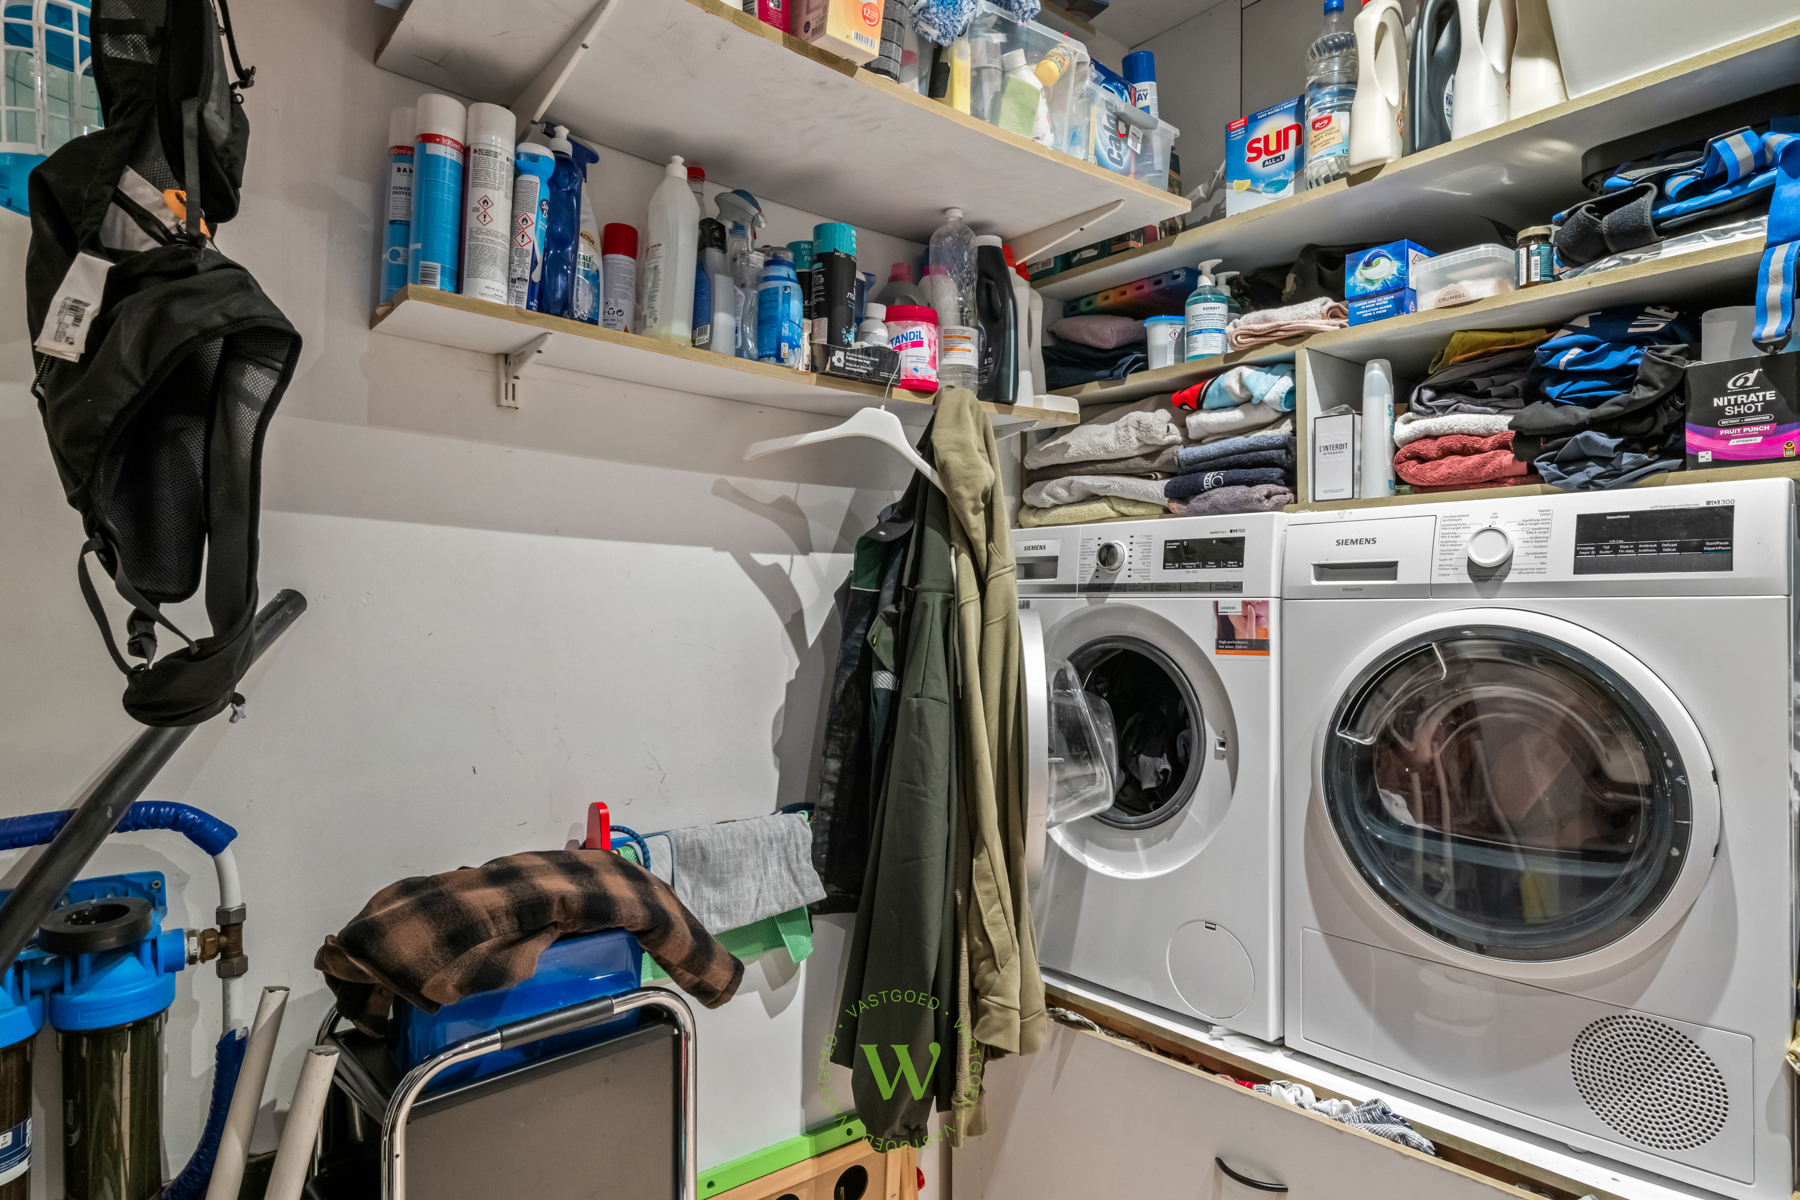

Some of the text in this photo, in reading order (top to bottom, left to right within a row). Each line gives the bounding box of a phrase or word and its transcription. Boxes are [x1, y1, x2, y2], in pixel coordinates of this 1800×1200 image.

[864, 8, 870, 17] 12
[1137, 92, 1148, 102] AY
[442, 138, 460, 149] 100ml
[1245, 123, 1303, 163] sun
[580, 233, 595, 245] ACTIVE
[1438, 293, 1466, 303] CRUMBEL
[1714, 390, 1776, 407] NITRATE
[1725, 402, 1764, 416] SHOT
[1319, 442, 1348, 452] L'INTERDIT
[1336, 538, 1377, 546] SIEMENS
